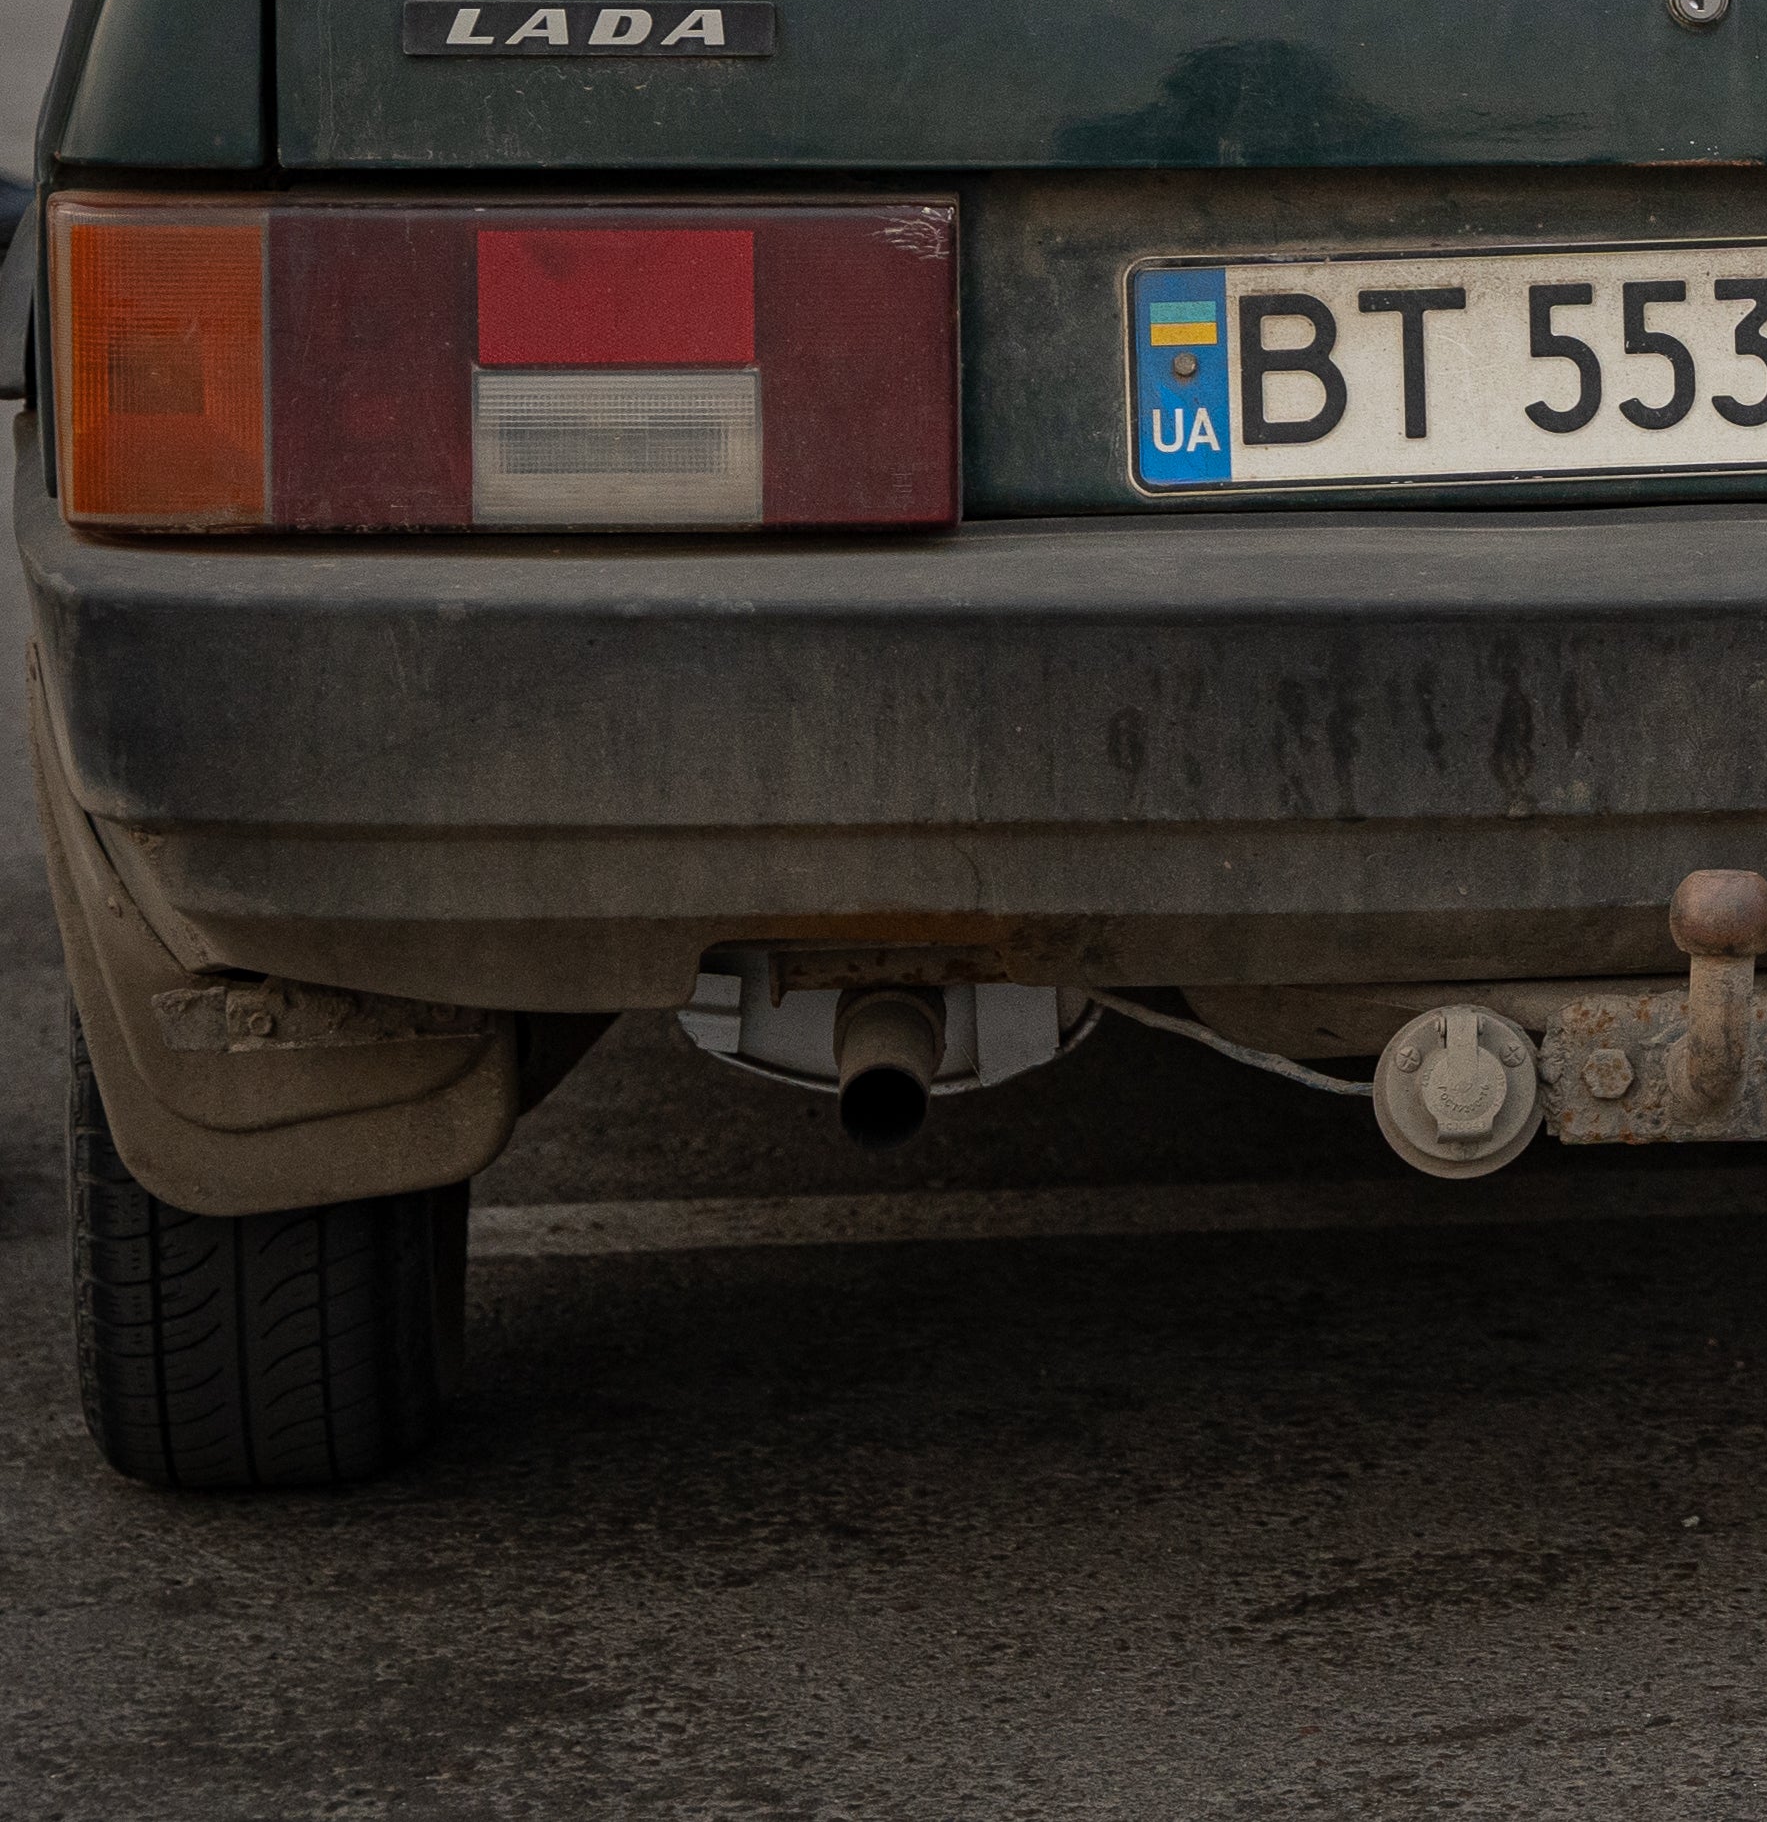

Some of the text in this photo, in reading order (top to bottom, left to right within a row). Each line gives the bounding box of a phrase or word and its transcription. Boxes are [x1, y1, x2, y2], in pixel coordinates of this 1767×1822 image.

[445, 7, 726, 46] LADA
[1238, 285, 1469, 446] BT
[1150, 406, 1222, 454] UA
